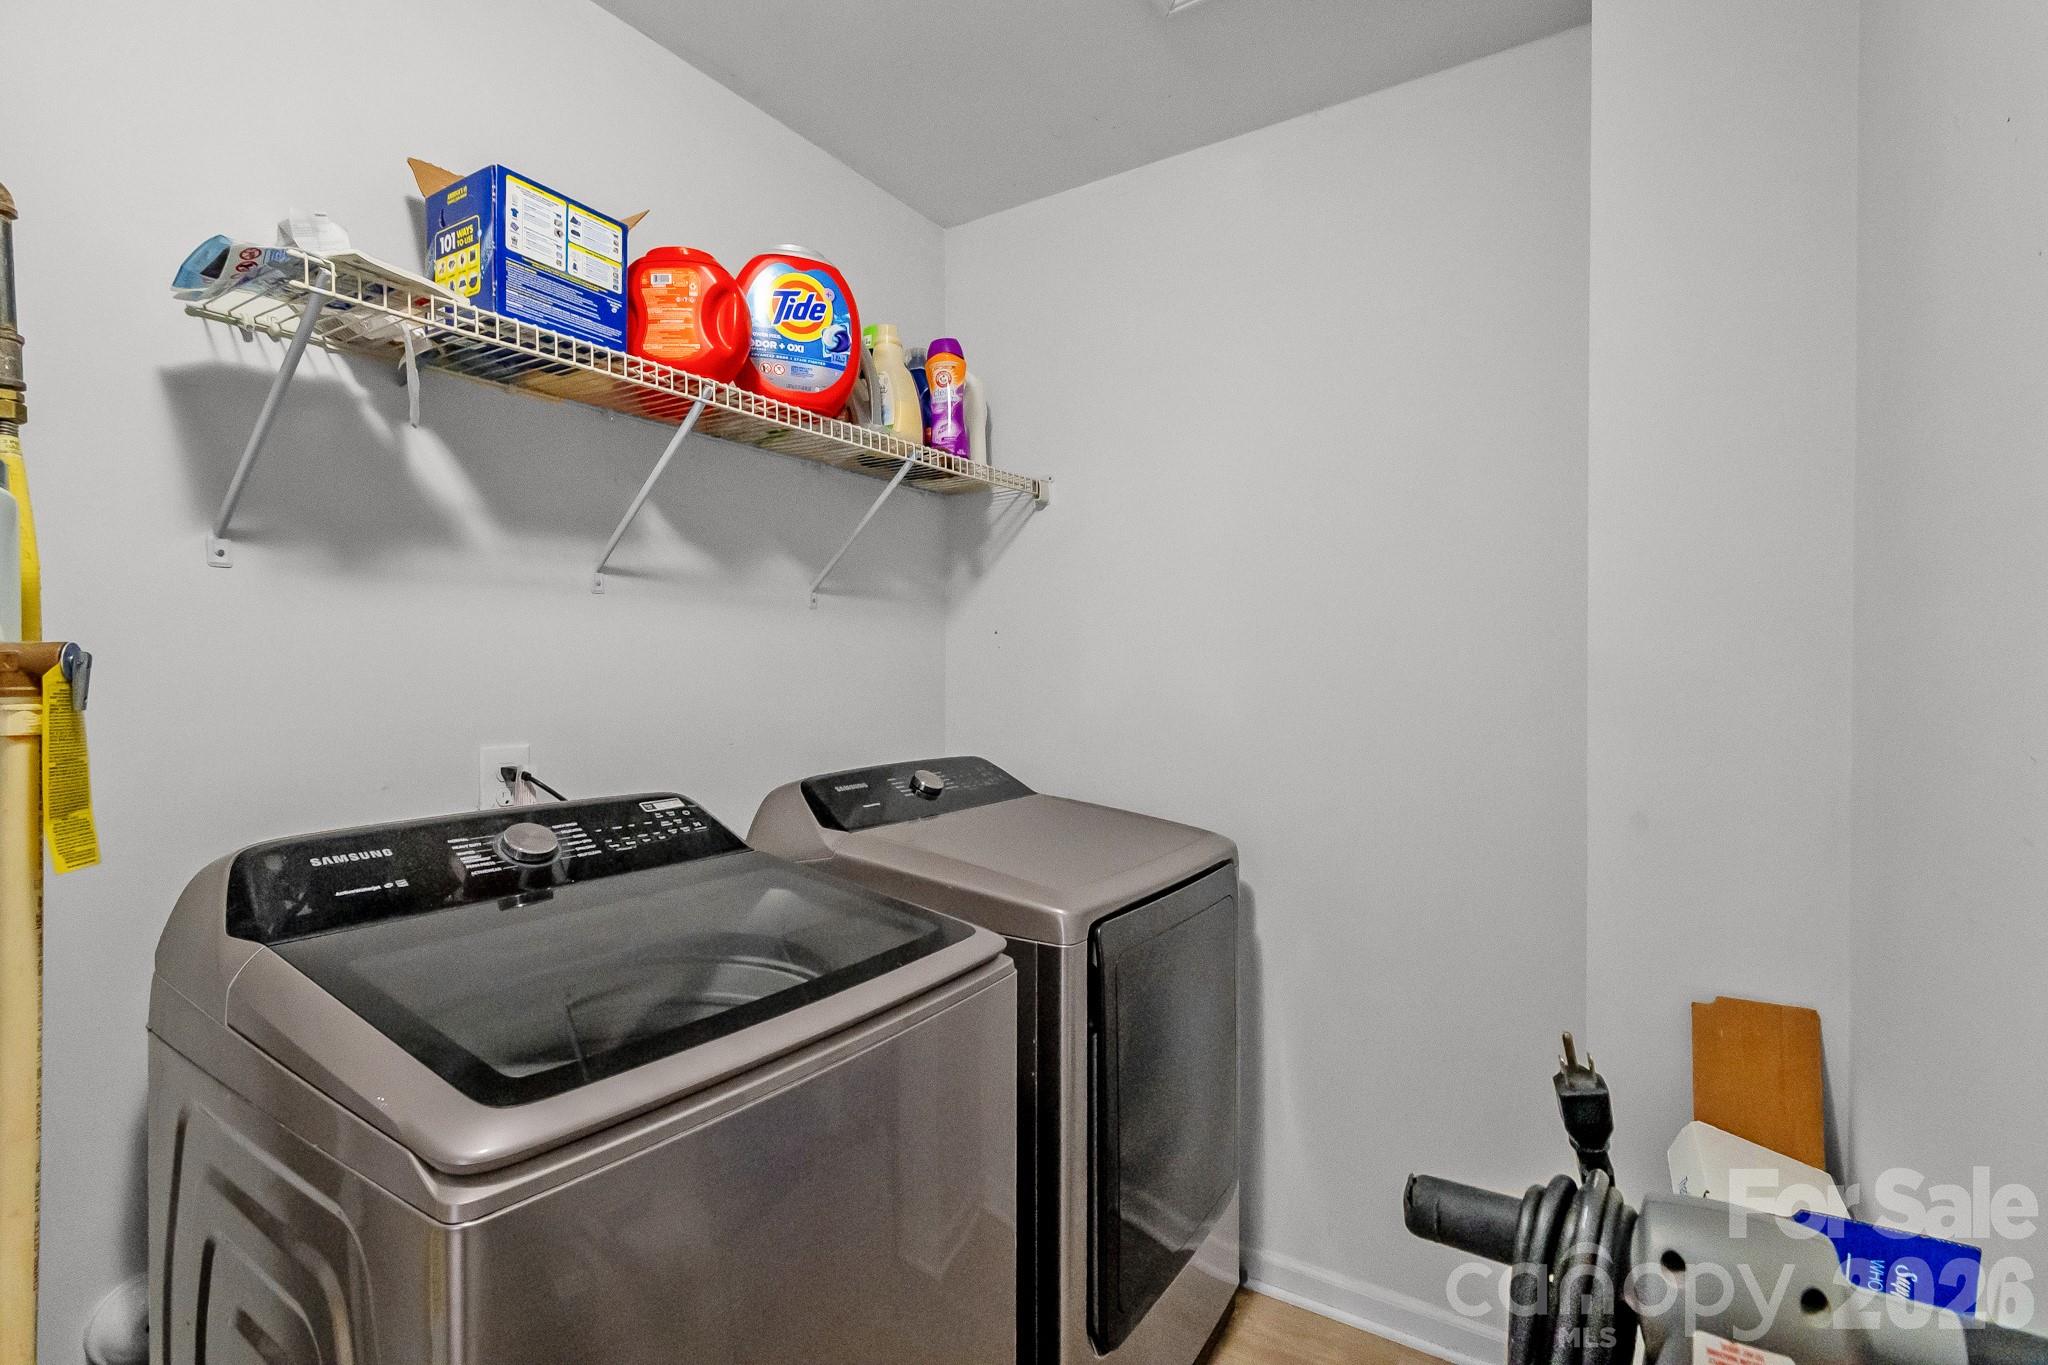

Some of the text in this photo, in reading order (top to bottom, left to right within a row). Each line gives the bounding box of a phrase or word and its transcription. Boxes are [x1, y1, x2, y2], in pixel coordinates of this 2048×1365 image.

[456, 224, 474, 239] WAYS
[440, 231, 456, 254] 101
[771, 289, 828, 325] Tide
[786, 343, 805, 353] OXI
[309, 848, 394, 868] SAMSUNG
